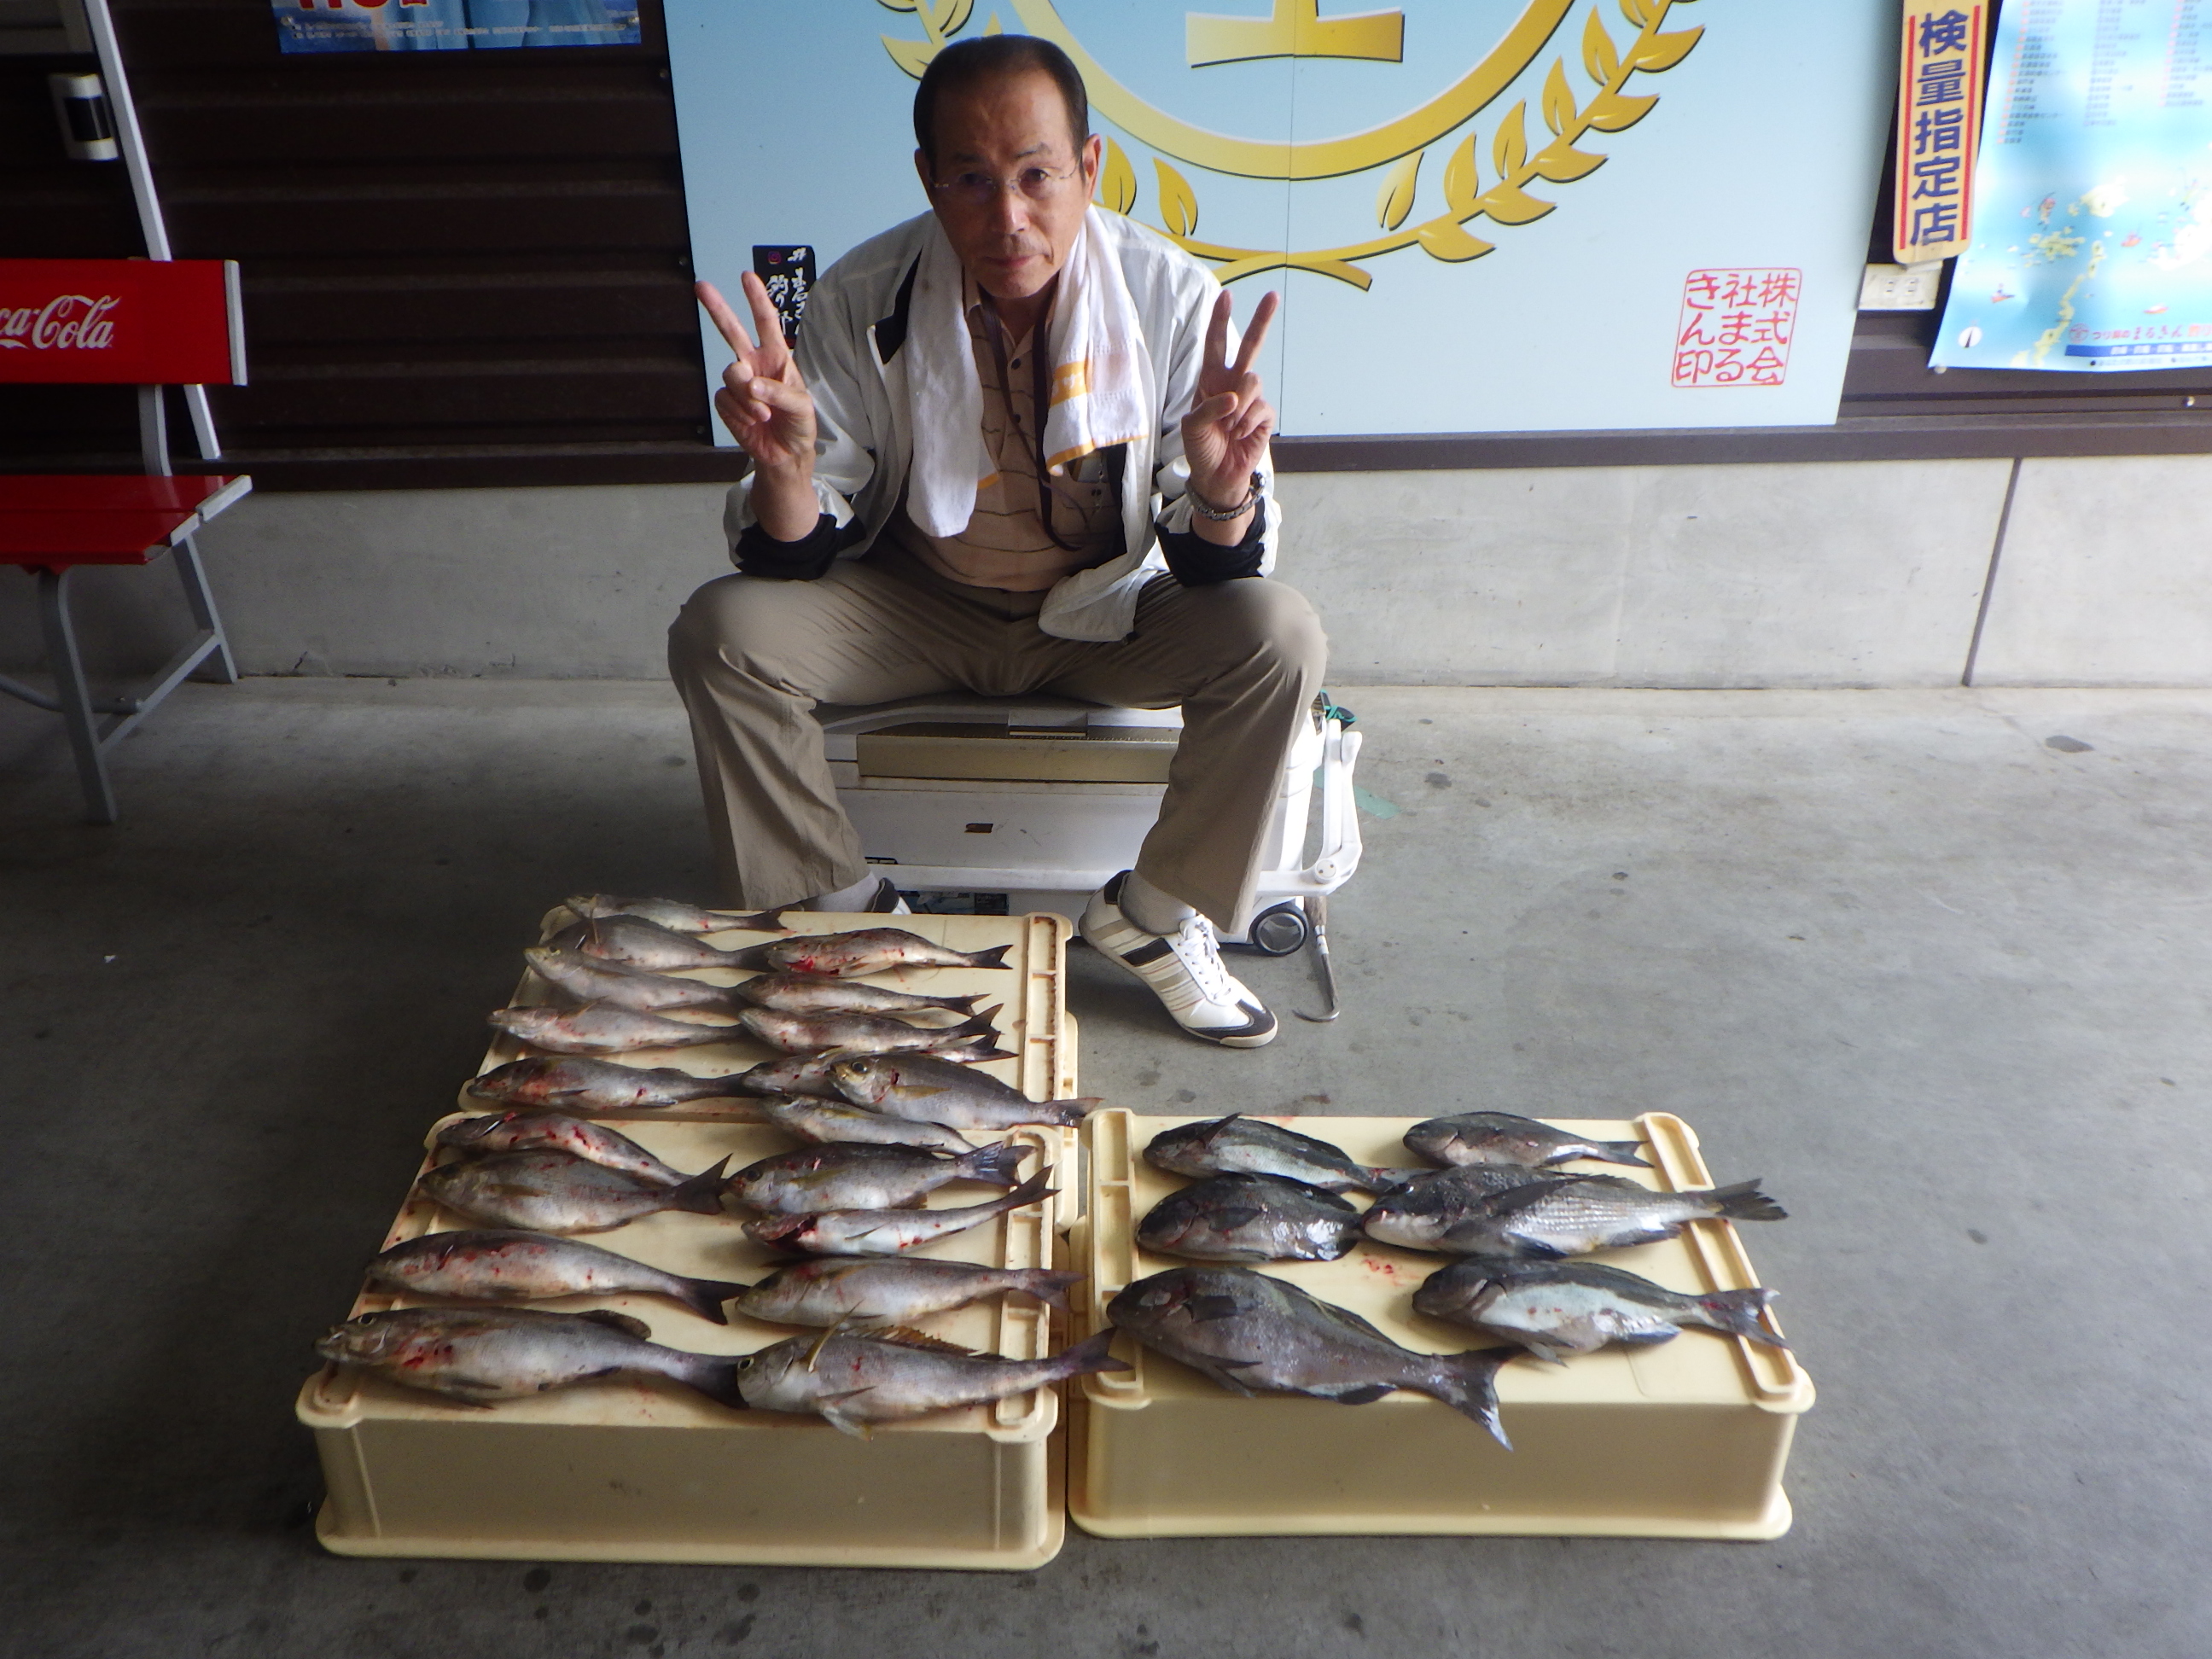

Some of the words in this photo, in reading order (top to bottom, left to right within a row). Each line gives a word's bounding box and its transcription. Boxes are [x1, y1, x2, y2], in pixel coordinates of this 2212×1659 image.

[1910, 9, 1969, 247] 検量指定店
